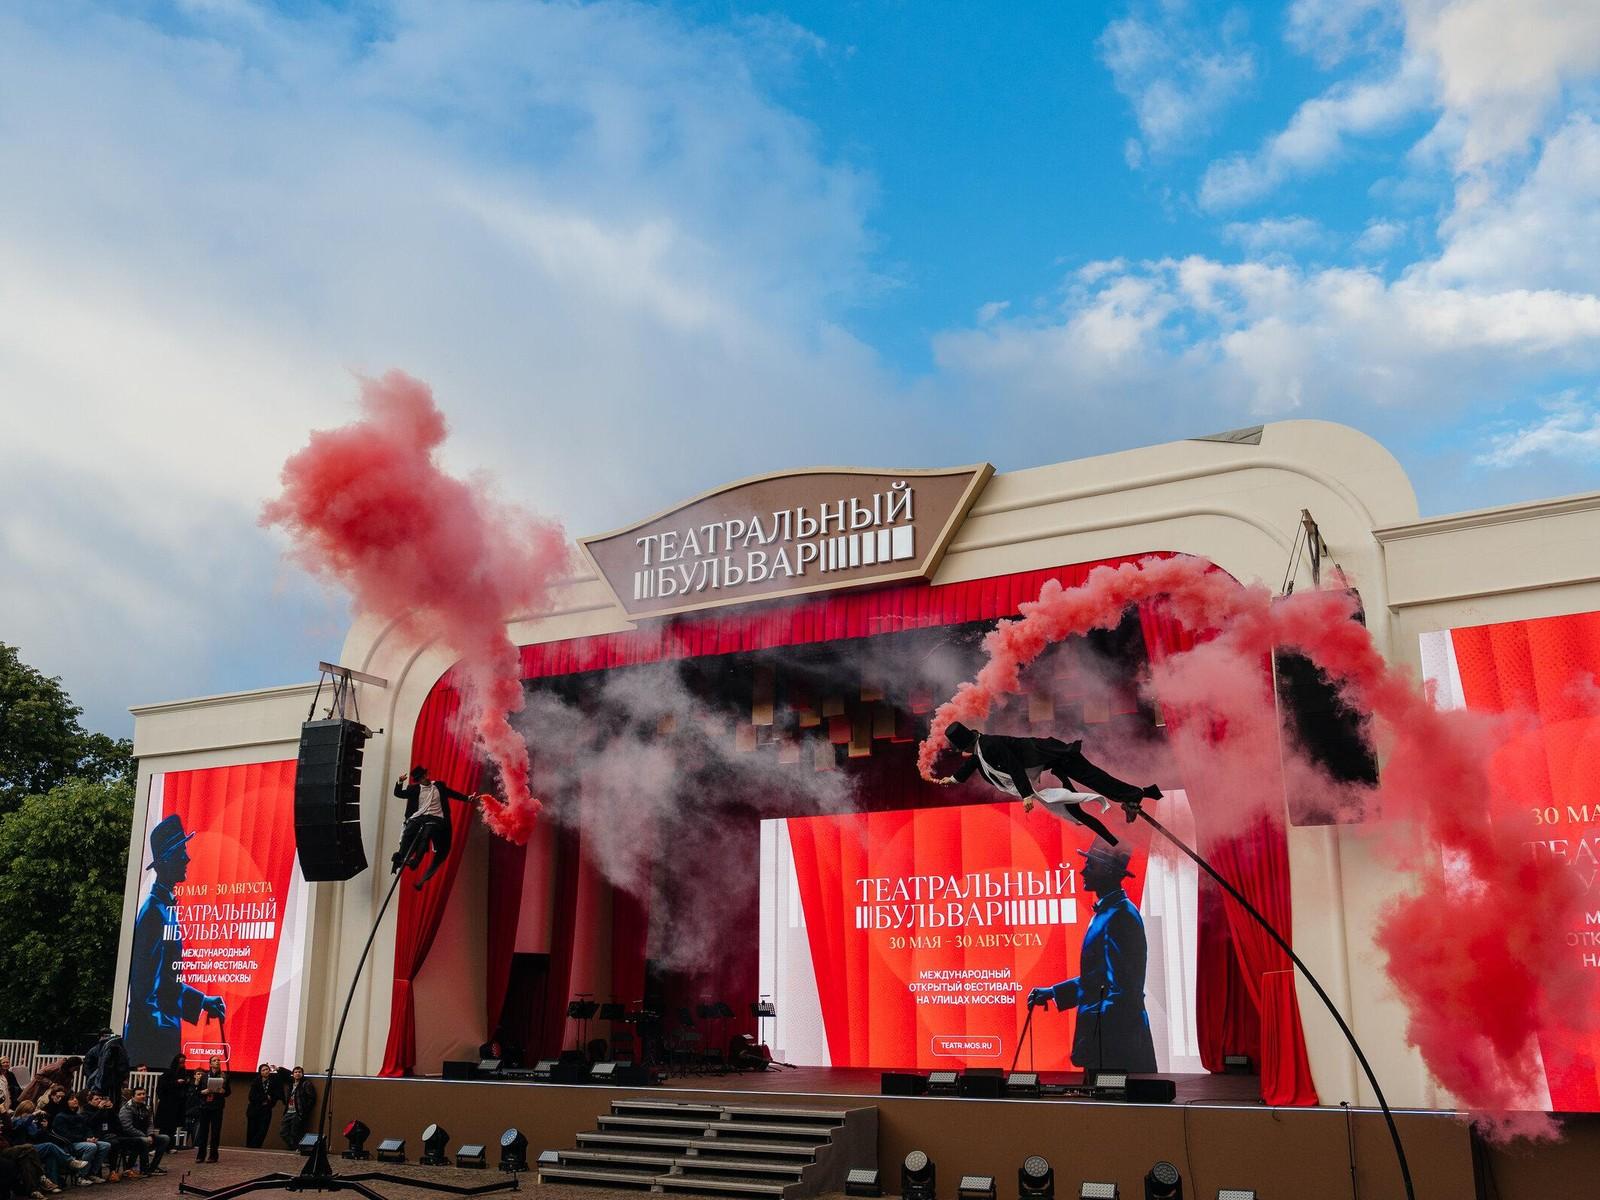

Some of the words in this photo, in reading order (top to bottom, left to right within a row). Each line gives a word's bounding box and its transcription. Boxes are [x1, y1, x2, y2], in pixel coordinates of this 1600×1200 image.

[636, 480, 914, 566] ТЕАТРАЛЬНЫЙ
[658, 542, 819, 598] БУЛЬВАР
[1531, 806, 1560, 825] 30
[173, 885, 184, 897] 30
[186, 884, 208, 896] МАЯ
[216, 883, 228, 895] 30
[229, 881, 273, 894] АВГУСТА
[855, 863, 1077, 902] ТЕАТРАЛЬНЫЙ
[166, 897, 277, 922] ТЕАТРАЛЬНЫЙ
[875, 901, 1004, 930] БУЛЬВАР
[173, 922, 239, 941] БУЛЬВАР
[889, 936, 906, 950] 30
[909, 935, 942, 949] МАЯ
[955, 934, 972, 948] 30
[975, 932, 1043, 947] АВГУСТА
[181, 946, 251, 958] МЕЖДУНАРОДНЫЙ
[171, 960, 213, 970] ОТКРЫТЫЙ
[213, 960, 258, 970] ФЕСТИВАЛЬ
[919, 967, 1011, 980] МЕЖДУНАРОДНЫЙ
[175, 974, 187, 983] НА
[187, 974, 217, 984] УЛИЦАХ
[217, 973, 252, 983] МОСКВЫ
[908, 980, 963, 992] ОТКРЫТЫЙ
[963, 981, 1023, 992] ФЕСТИВАЛЬ
[916, 995, 930, 1005] НА
[931, 994, 970, 1006] УЛИЦАХ
[971, 994, 1016, 1005] МОСКВЫ
[940, 1041, 993, 1050] TEATR.MOS.RU
